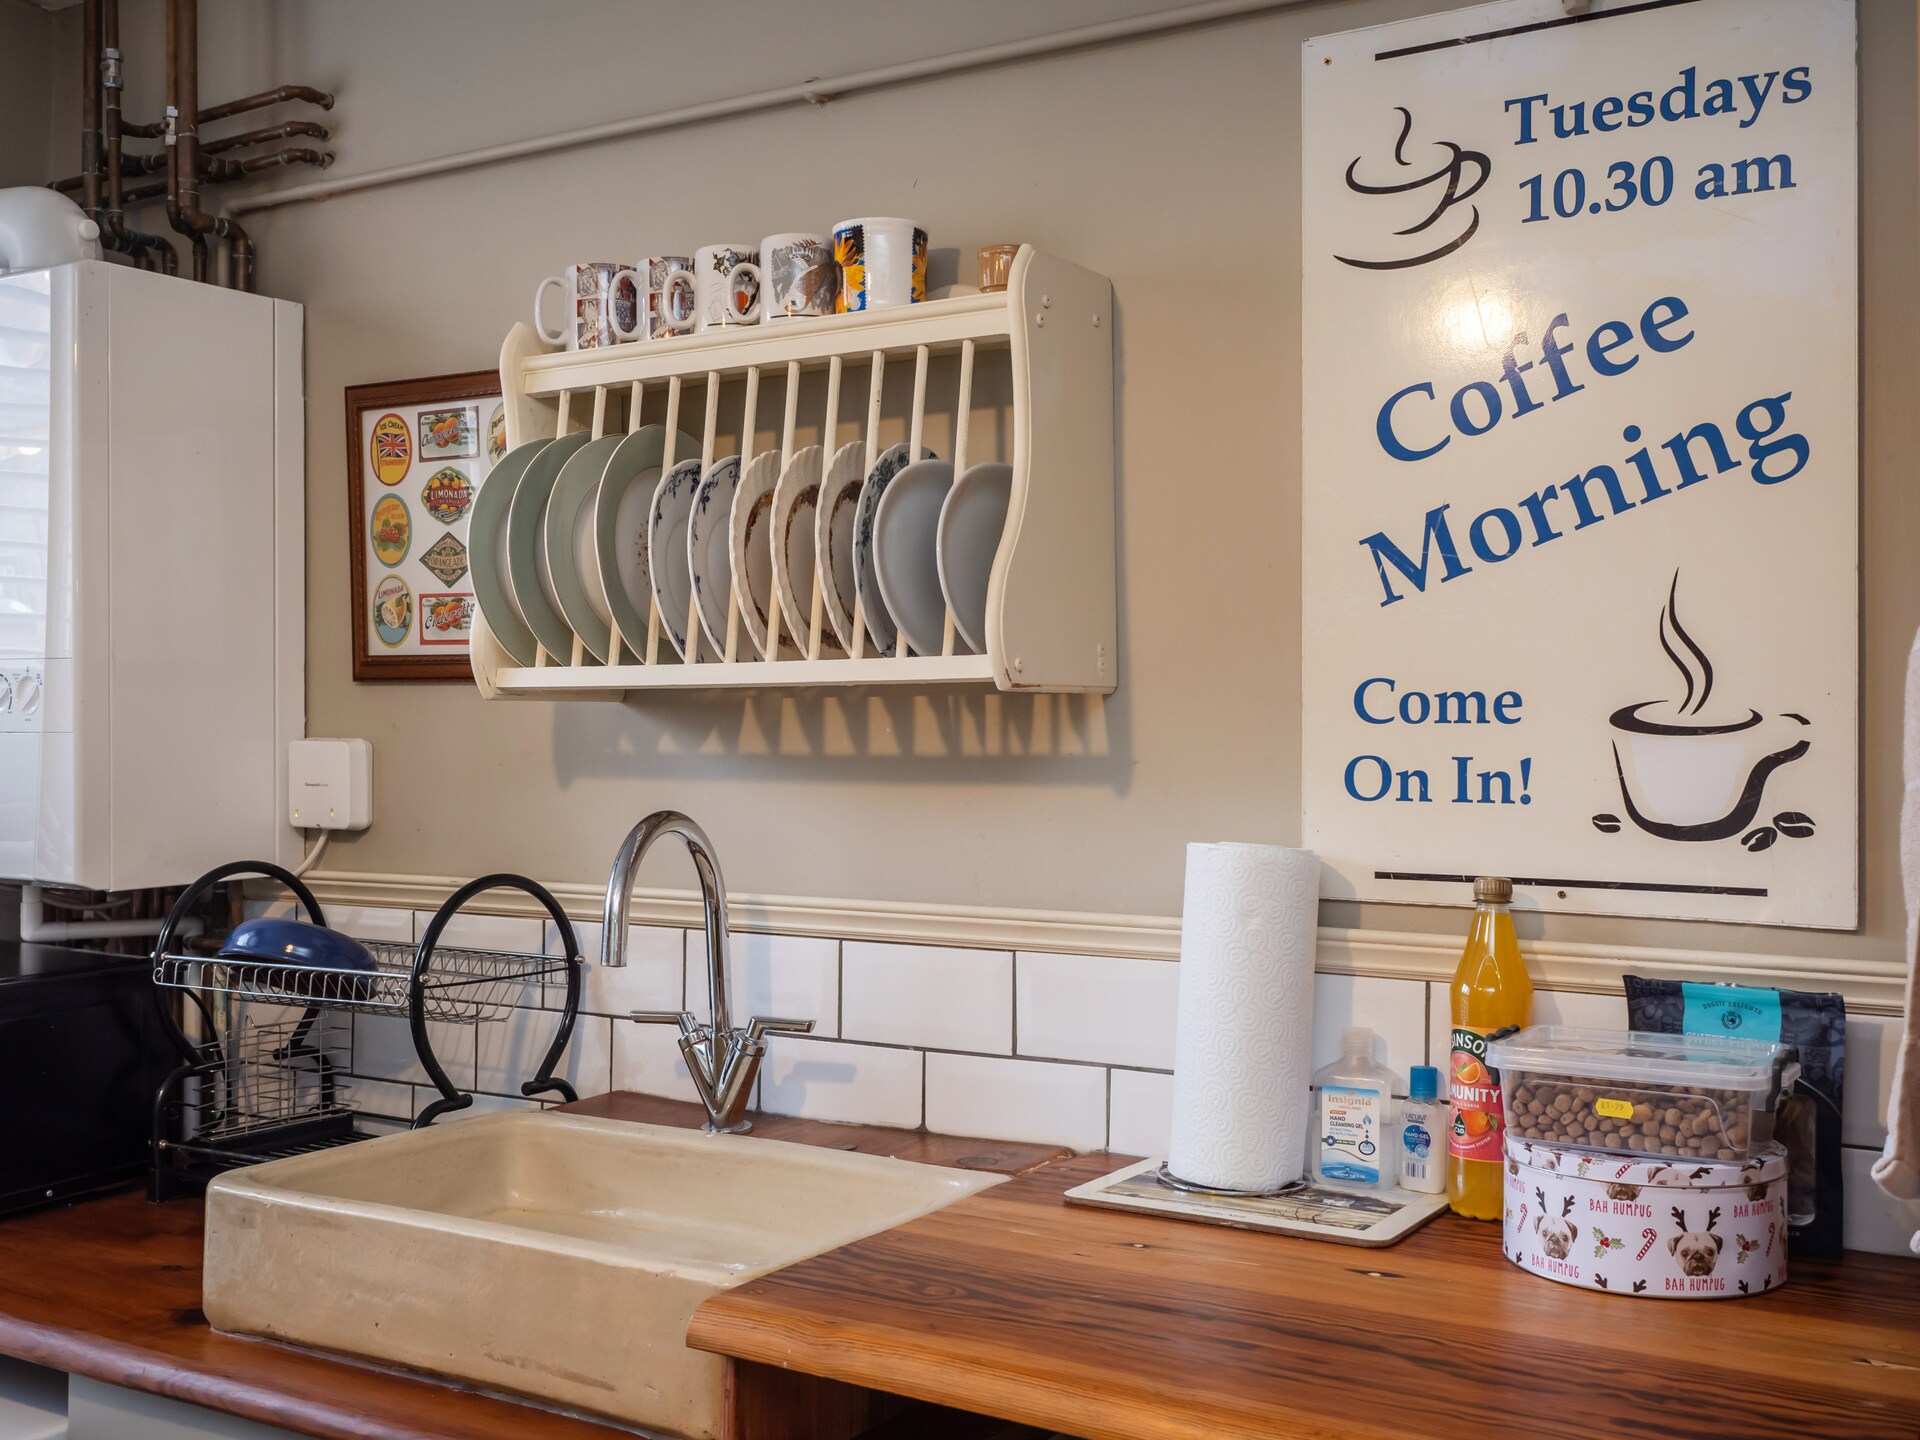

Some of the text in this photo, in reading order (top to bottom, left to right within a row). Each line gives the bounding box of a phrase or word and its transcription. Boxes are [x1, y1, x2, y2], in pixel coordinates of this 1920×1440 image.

[1505, 66, 1812, 145] Tuesdays
[1519, 152, 1796, 223] 10.30 am
[1376, 296, 1695, 462] Coffee
[387, 420, 404, 430] CREAM
[431, 489, 468, 500] LIMONADA
[1359, 391, 1810, 607] Morning
[430, 554, 465, 567] ORANGEADE
[378, 585, 404, 599] LIMONADA
[425, 602, 475, 630] Ciderette
[1353, 678, 1523, 724] Come
[1344, 755, 1532, 805] On In!
[1728, 1001, 1763, 1015] DELIGHTS
[1328, 1094, 1372, 1107] Insignia
[1329, 1121, 1355, 1129] CLEANSING
[1590, 1199, 1652, 1217] BAH HUMPUG
[1733, 1200, 1774, 1218] BAH HUMPUG
[1532, 1254, 1580, 1279] BAH HUMPUG
[1665, 1278, 1726, 1291] BAH HUMPUG
